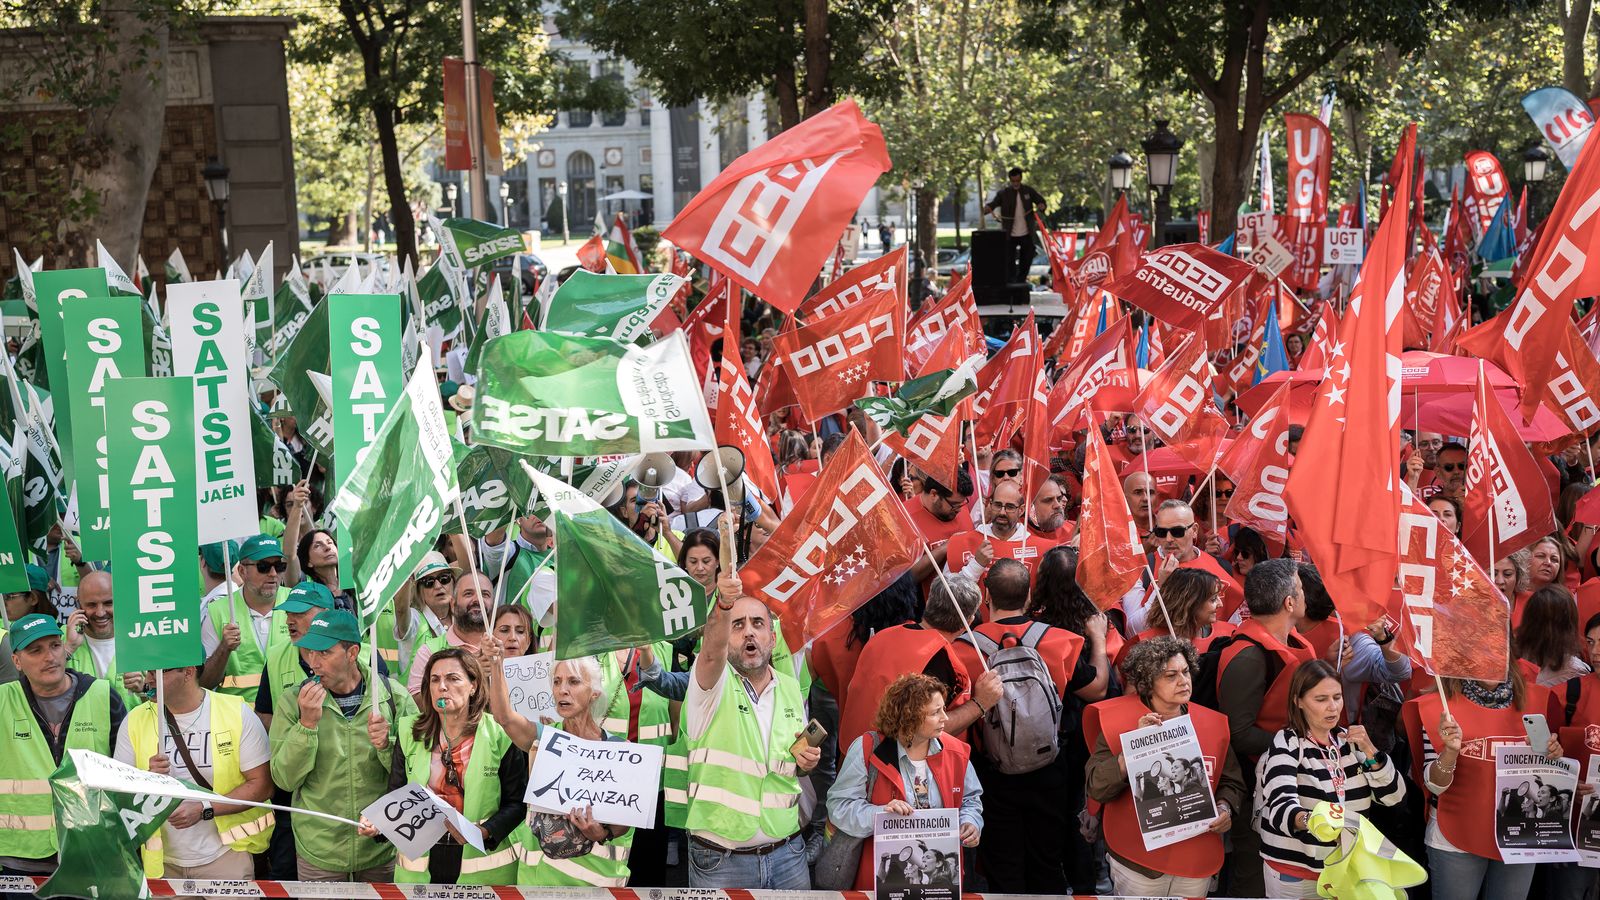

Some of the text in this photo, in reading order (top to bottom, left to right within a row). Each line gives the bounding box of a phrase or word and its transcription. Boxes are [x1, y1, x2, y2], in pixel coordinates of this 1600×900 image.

[464, 234, 522, 263] SATSE
[1330, 231, 1357, 246] UGT
[192, 302, 235, 482] SATSE
[199, 484, 245, 504] JAÉN
[130, 400, 177, 614] SATSE
[128, 615, 189, 639] JAÉN
[544, 732, 642, 765] ESTATUTO
[1131, 725, 1188, 750] CONCENTRACIÓN
[1504, 754, 1570, 771] CONCENTRACIÓN
[578, 766, 618, 784] PARA
[533, 769, 643, 813] AVANZAR
[883, 816, 950, 829] CONCENTRACIÓN
